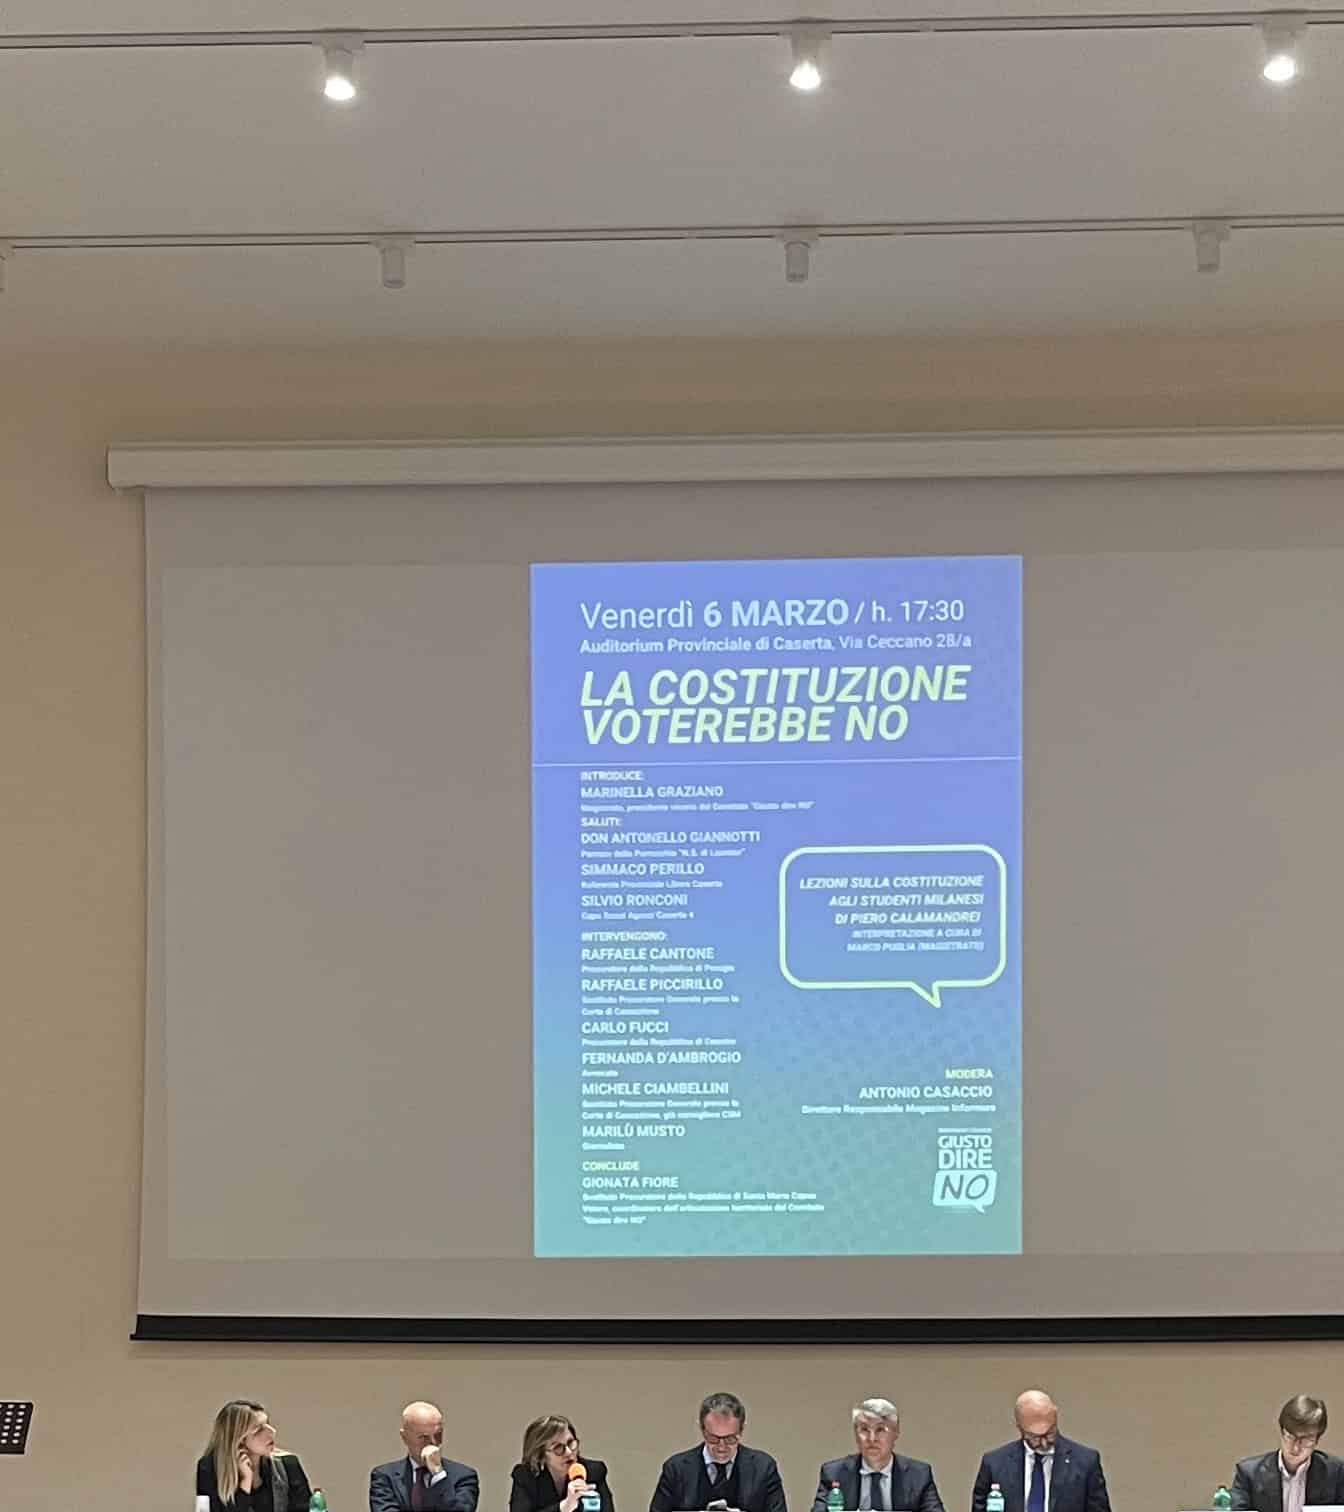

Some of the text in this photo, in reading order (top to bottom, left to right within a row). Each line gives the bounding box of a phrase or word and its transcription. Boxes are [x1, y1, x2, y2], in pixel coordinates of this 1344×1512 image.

[580, 598, 964, 630] Venerdì 6 MARZO / h. 17:30
[579, 633, 972, 654] Auditorium Provinciale di Caserta, Via Ceccano 28/a
[580, 665, 972, 707] LA COSTITUZIONE
[582, 704, 909, 745] VOTEREBBE NO
[580, 785, 724, 799] MARINELLA GRAZIANO
[580, 830, 761, 845] DON ANTONELLO GIANNOTTI
[580, 862, 705, 876] SIMMACO PERILLO
[799, 875, 985, 889] LEZIONI SULLA COSTITUZIONE
[581, 893, 688, 907] SILVIO RONCONI
[829, 893, 985, 907] AGLI STUDENTI MILANESI
[834, 911, 981, 925] DI PIERO CALAMANDREI
[581, 947, 715, 961] RAFFAELE CANTONE
[581, 977, 724, 992] RAFFAELE PICCIRILLO
[581, 1021, 669, 1034] CARLO FUCCI
[582, 1051, 742, 1065] FERNANDA D'AMBROGIO
[581, 1082, 729, 1095] MICHELE CIAMBELLINI
[859, 1085, 993, 1099] ANTONIO CASACCIO
[636, 1124, 686, 1137] MUSTO
[937, 1135, 992, 1149] GIUSTO
[938, 1149, 993, 1169] DIRE
[582, 1176, 679, 1189] GIONATA FIORE
[940, 1173, 990, 1201] NO
